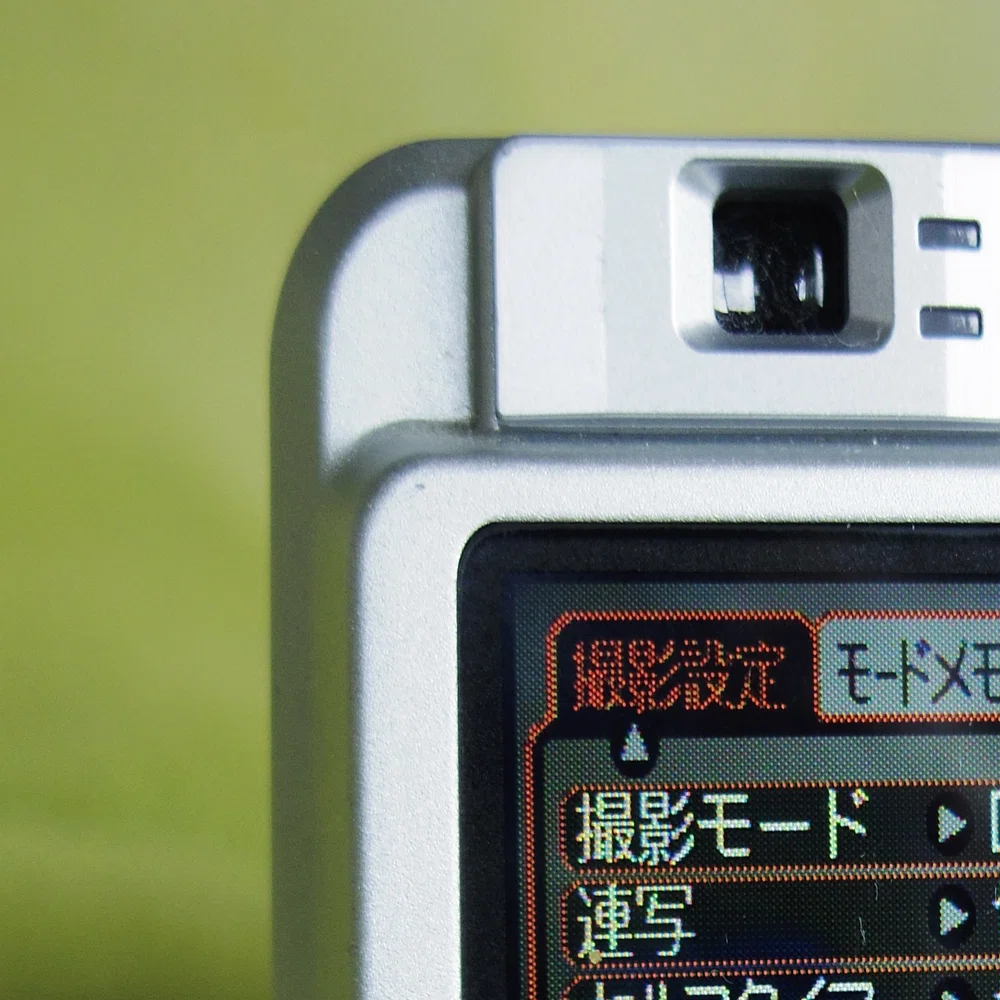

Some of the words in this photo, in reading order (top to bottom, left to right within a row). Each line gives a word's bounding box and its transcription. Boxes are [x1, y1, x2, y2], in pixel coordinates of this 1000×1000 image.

[572, 638, 787, 713] 撮影設定
[575, 788, 870, 866] 撮影モード
[576, 883, 697, 959] 連写
